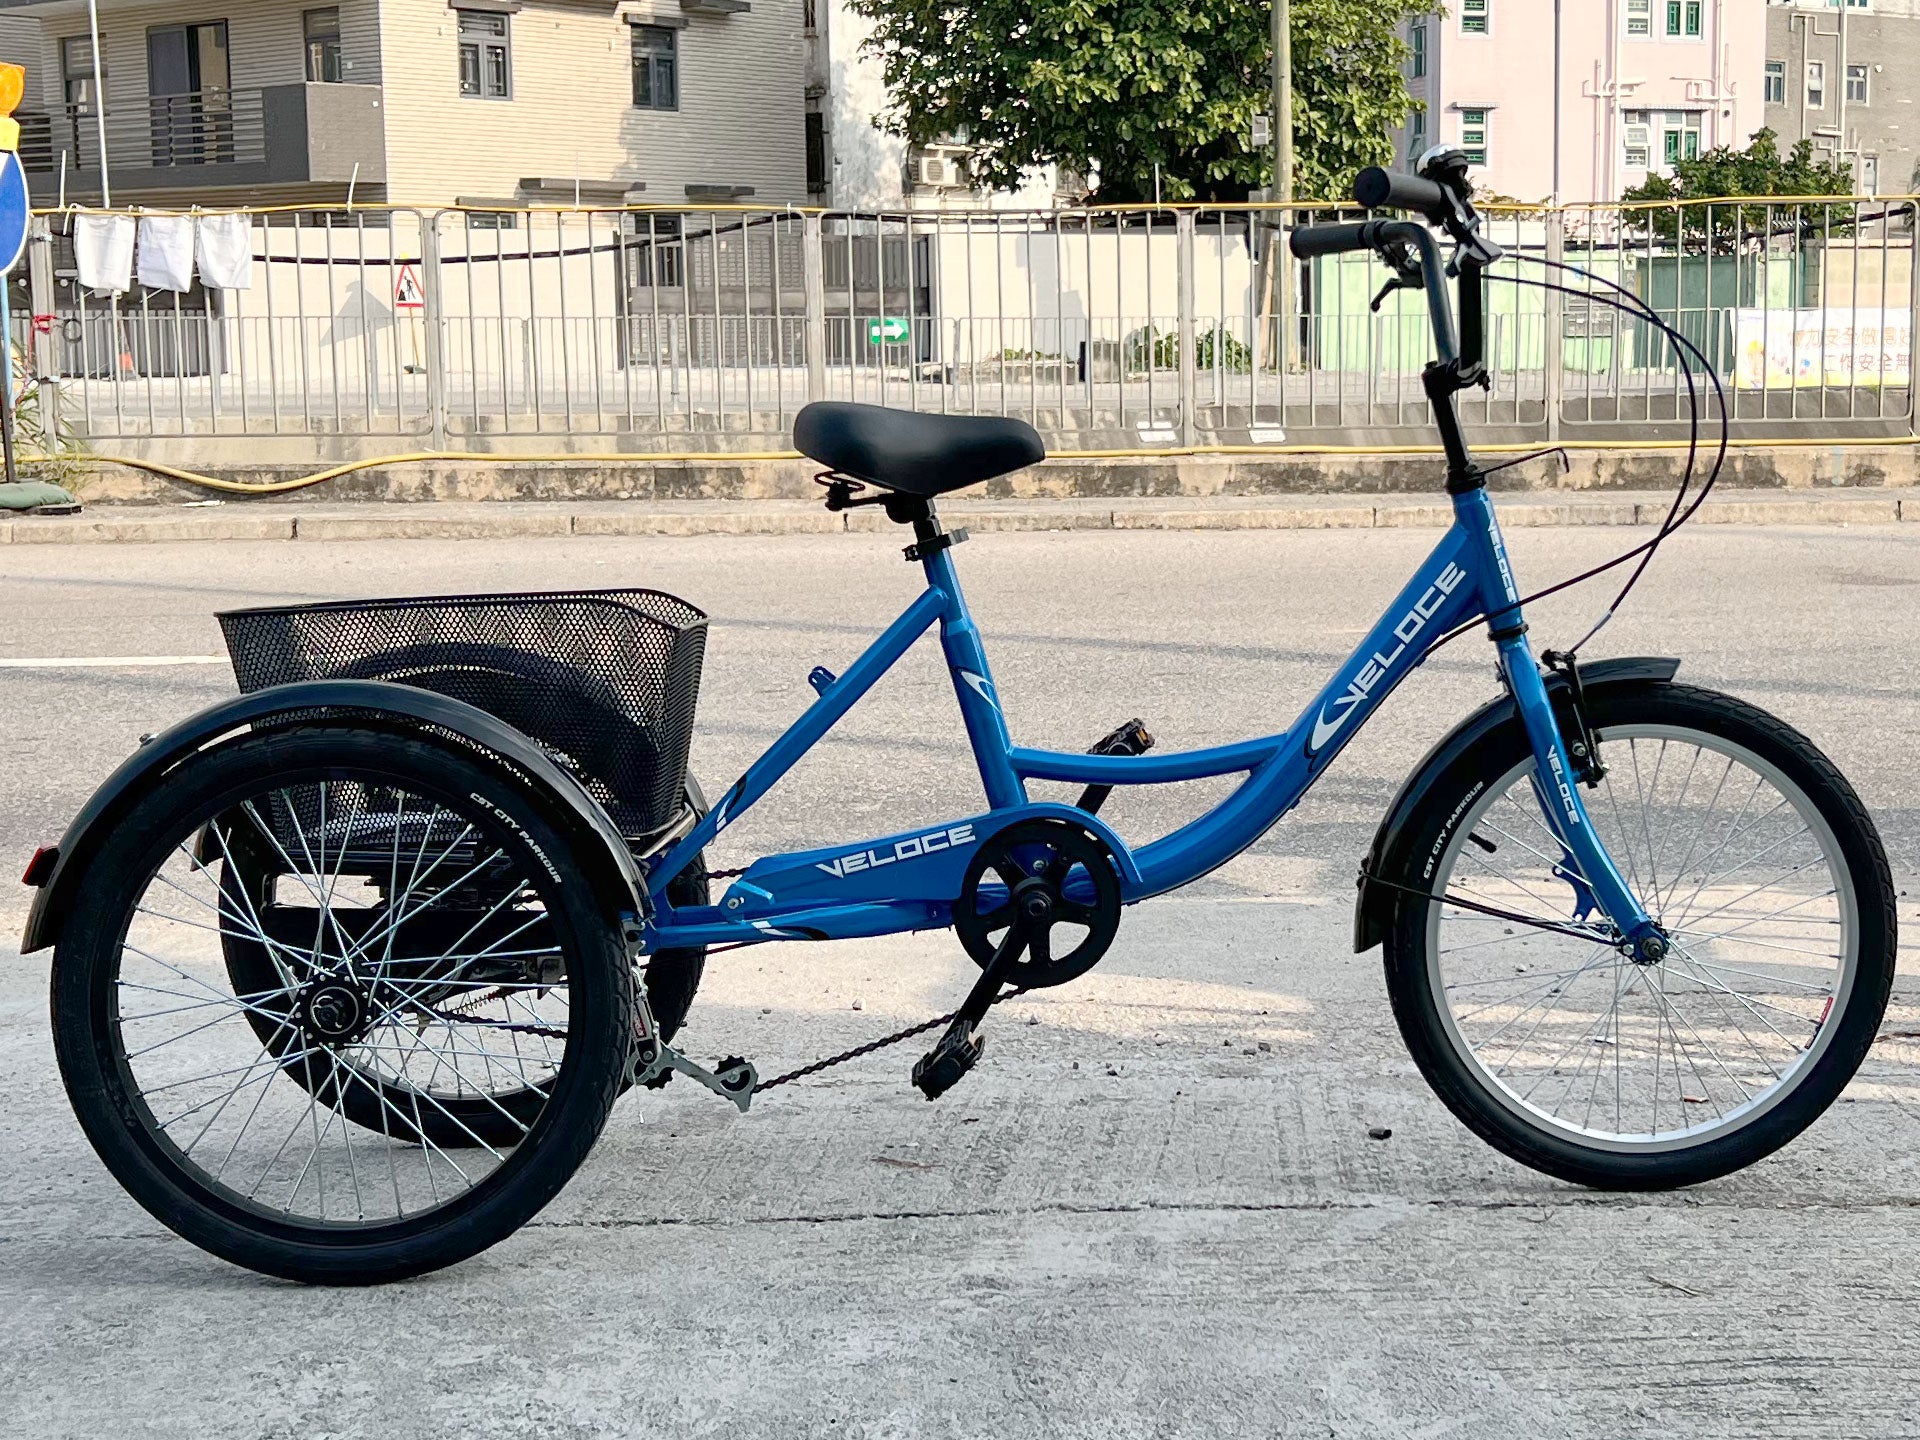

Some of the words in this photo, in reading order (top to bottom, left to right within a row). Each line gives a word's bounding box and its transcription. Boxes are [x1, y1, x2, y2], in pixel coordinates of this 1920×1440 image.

[1488, 516, 1518, 604] VELOCE
[1333, 561, 1467, 706] VELOCE
[1547, 744, 1580, 825] VELOCE
[470, 792, 495, 809] CST
[494, 808, 520, 829] CITY
[519, 830, 562, 884] PARKOUR
[815, 823, 976, 879] VELOCE
[1423, 856, 1435, 879] CST
[1432, 829, 1446, 855] CITY
[1446, 781, 1484, 829] PARKOUR
